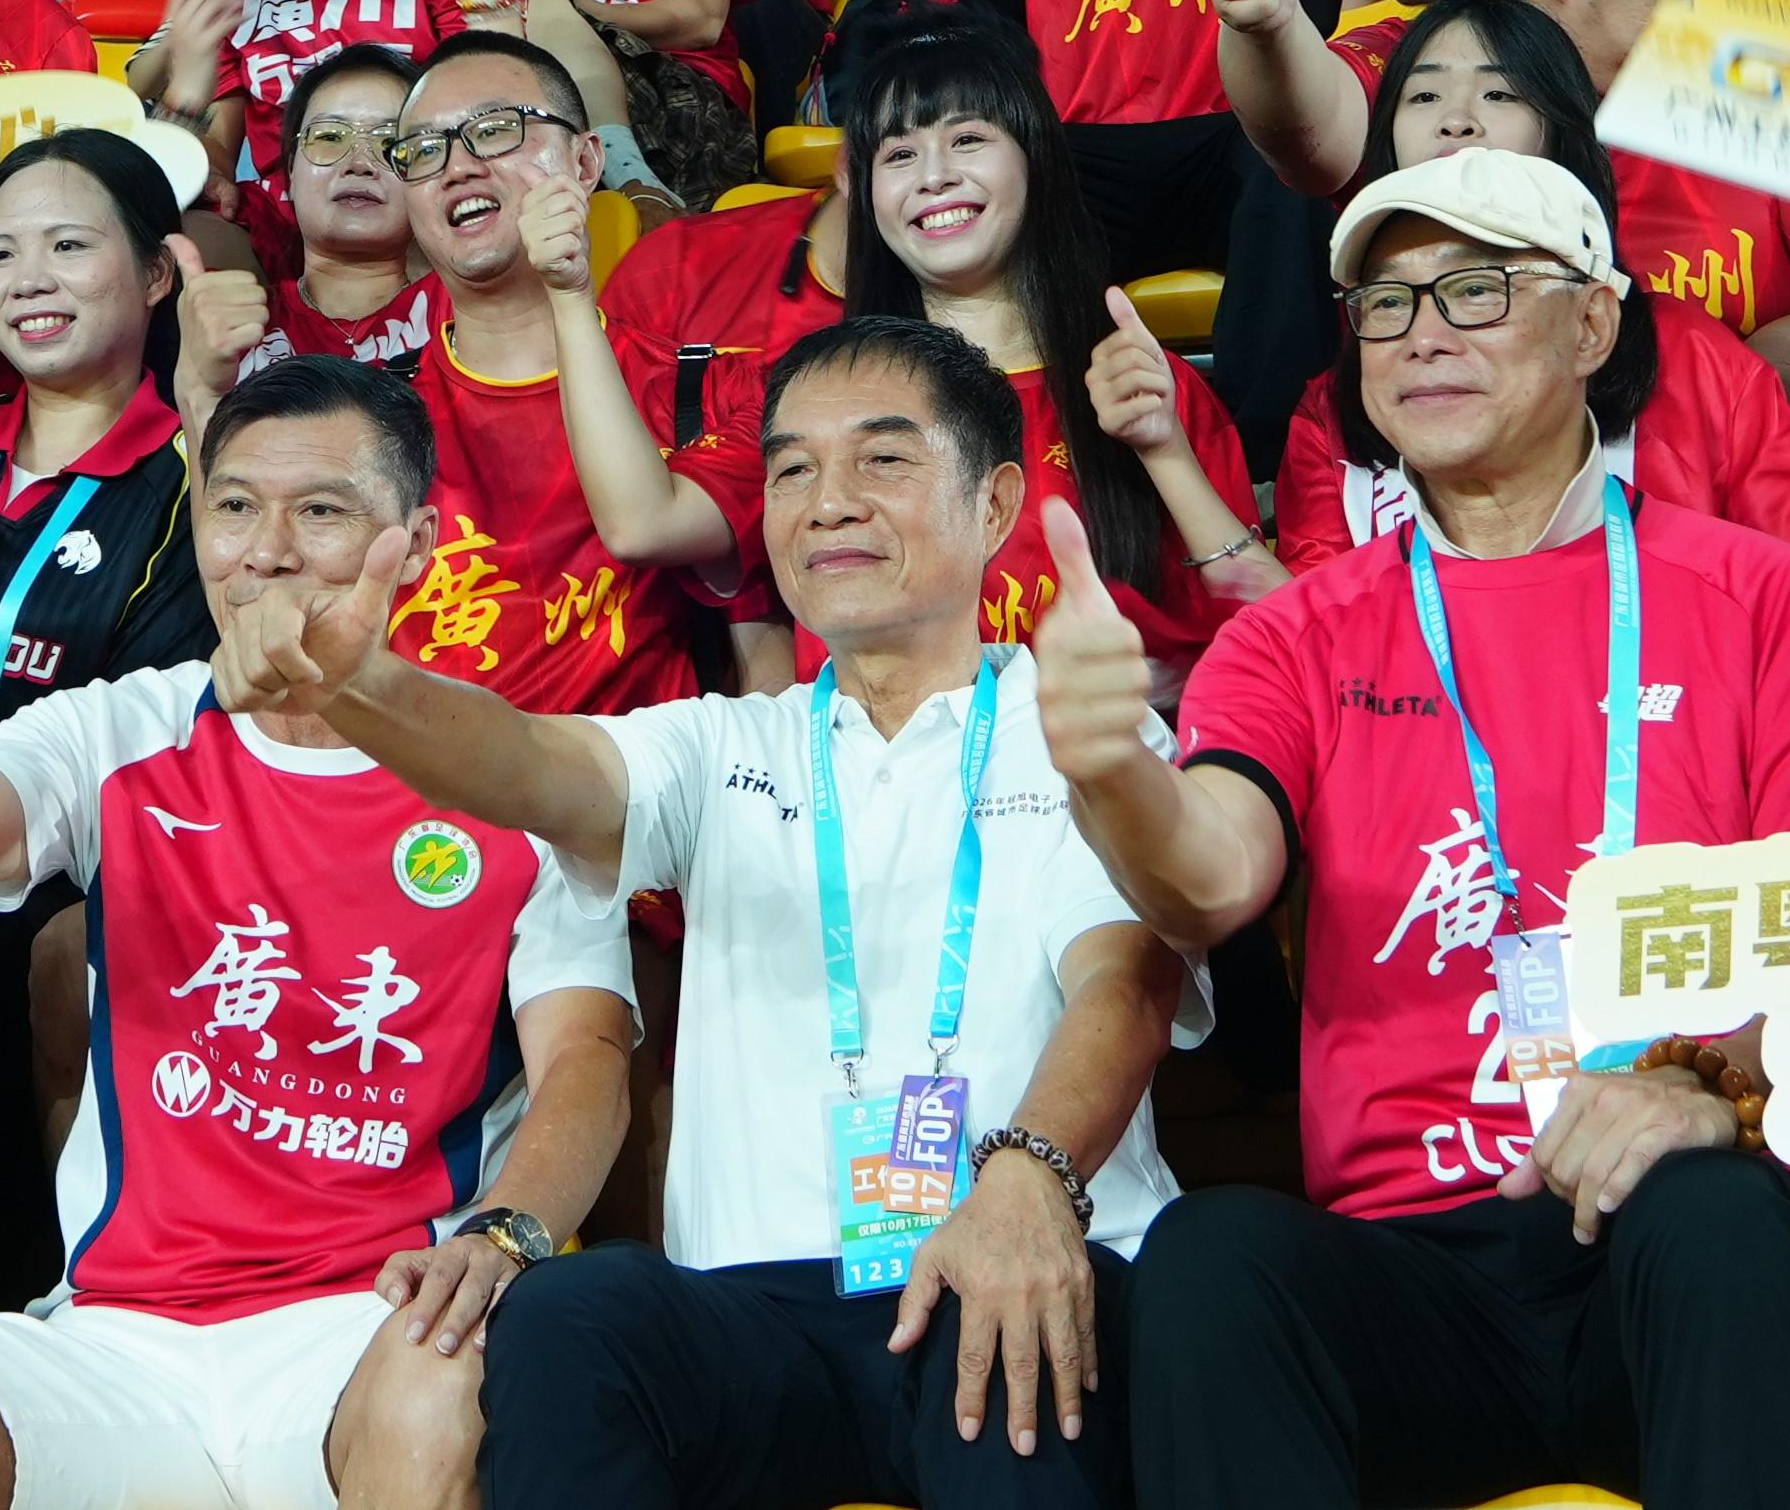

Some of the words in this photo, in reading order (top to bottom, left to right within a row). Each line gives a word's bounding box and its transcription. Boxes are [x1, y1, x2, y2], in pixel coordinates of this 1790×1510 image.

[1646, 228, 1755, 337] 州
[388, 514, 634, 672] 廣州
[170, 903, 423, 1074] 廣東
[1520, 956, 1563, 1027] FOP
[191, 1030, 406, 1106] GUANGDONG
[1512, 1040, 1540, 1079] 10
[1544, 1039, 1574, 1075] 17
[211, 1080, 409, 1169] 万力轮胎
[912, 1095, 956, 1165] FOP
[889, 1172, 916, 1208] 10
[920, 1174, 948, 1211] 17
